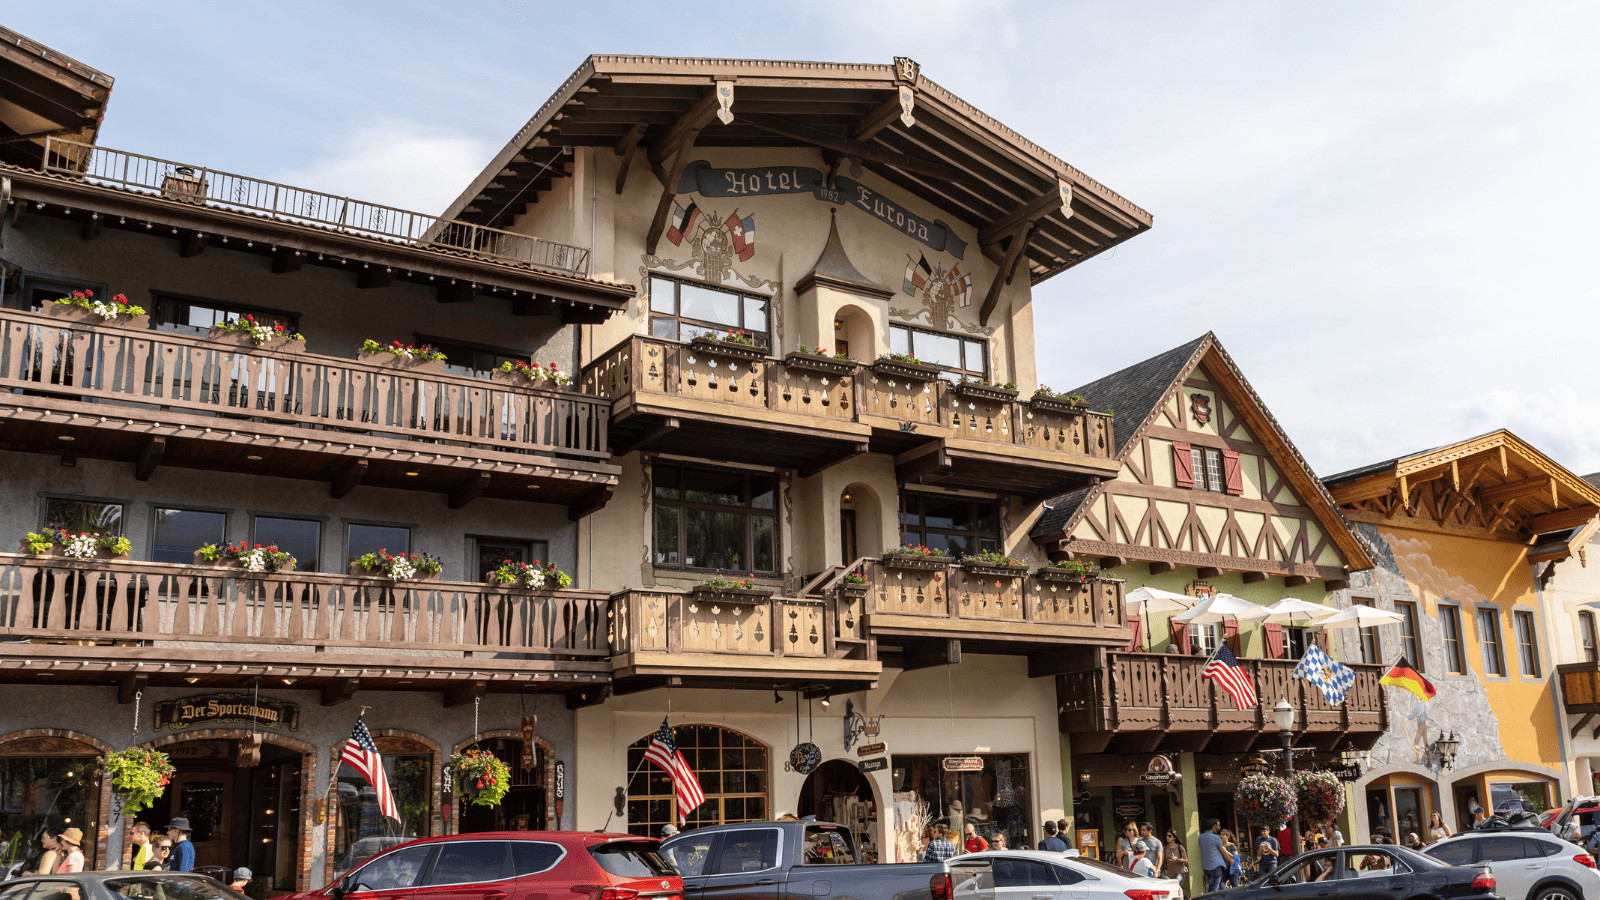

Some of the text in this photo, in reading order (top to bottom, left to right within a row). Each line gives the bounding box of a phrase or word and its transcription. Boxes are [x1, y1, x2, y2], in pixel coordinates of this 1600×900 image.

[725, 169, 803, 194] Hotel
[820, 188, 839, 201] 1982
[857, 186, 928, 241] Europa
[181, 699, 278, 721] Der Sportsmann
